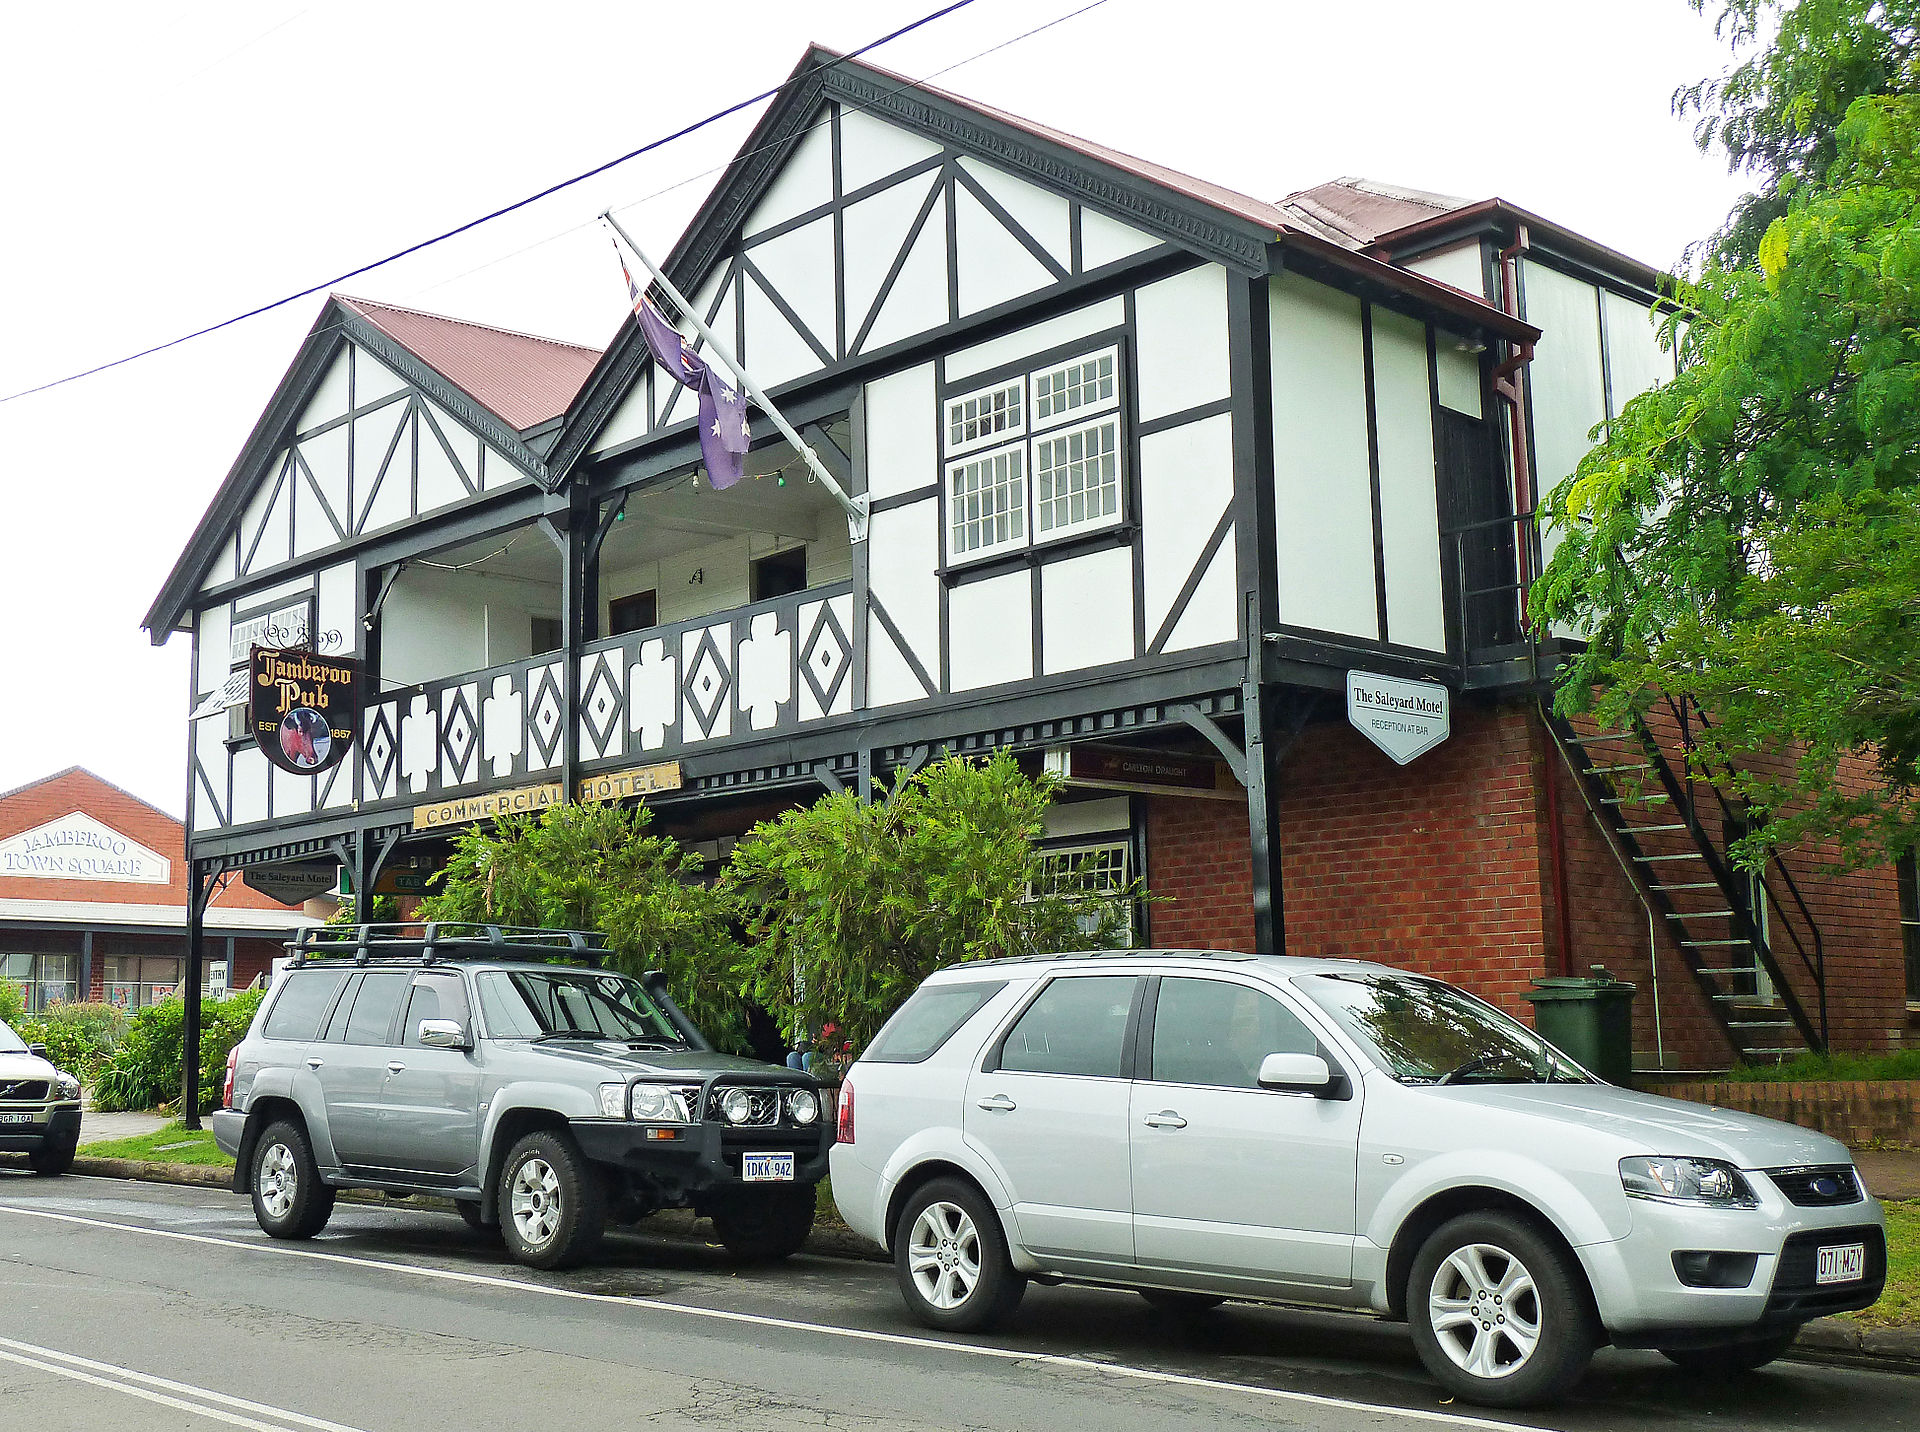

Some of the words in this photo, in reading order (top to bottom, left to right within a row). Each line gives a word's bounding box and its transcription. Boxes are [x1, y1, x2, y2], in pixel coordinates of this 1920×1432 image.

[257, 650, 352, 687] Jamberoo
[274, 678, 329, 717] Pub
[1353, 687, 1373, 703] The
[1375, 690, 1414, 710] Saleyard
[1415, 697, 1443, 714] Motel
[258, 721, 278, 732] EST
[330, 728, 352, 739] 1857
[1371, 719, 1406, 733] RECEPTION
[1407, 724, 1416, 734] AT
[1416, 725, 1429, 736] BAR
[1155, 765, 1186, 777] DRAUGHT
[426, 788, 562, 825] COMMERCIAL
[23, 830, 127, 856] JAMBEROO
[4, 852, 63, 871] TOWN
[68, 857, 142, 876] SQUARE
[249, 871, 267, 881] The
[268, 872, 305, 883] Saleyard
[307, 874, 332, 883] Motel
[210, 969, 226, 980] ENTRY
[210, 987, 225, 998] ONLY
